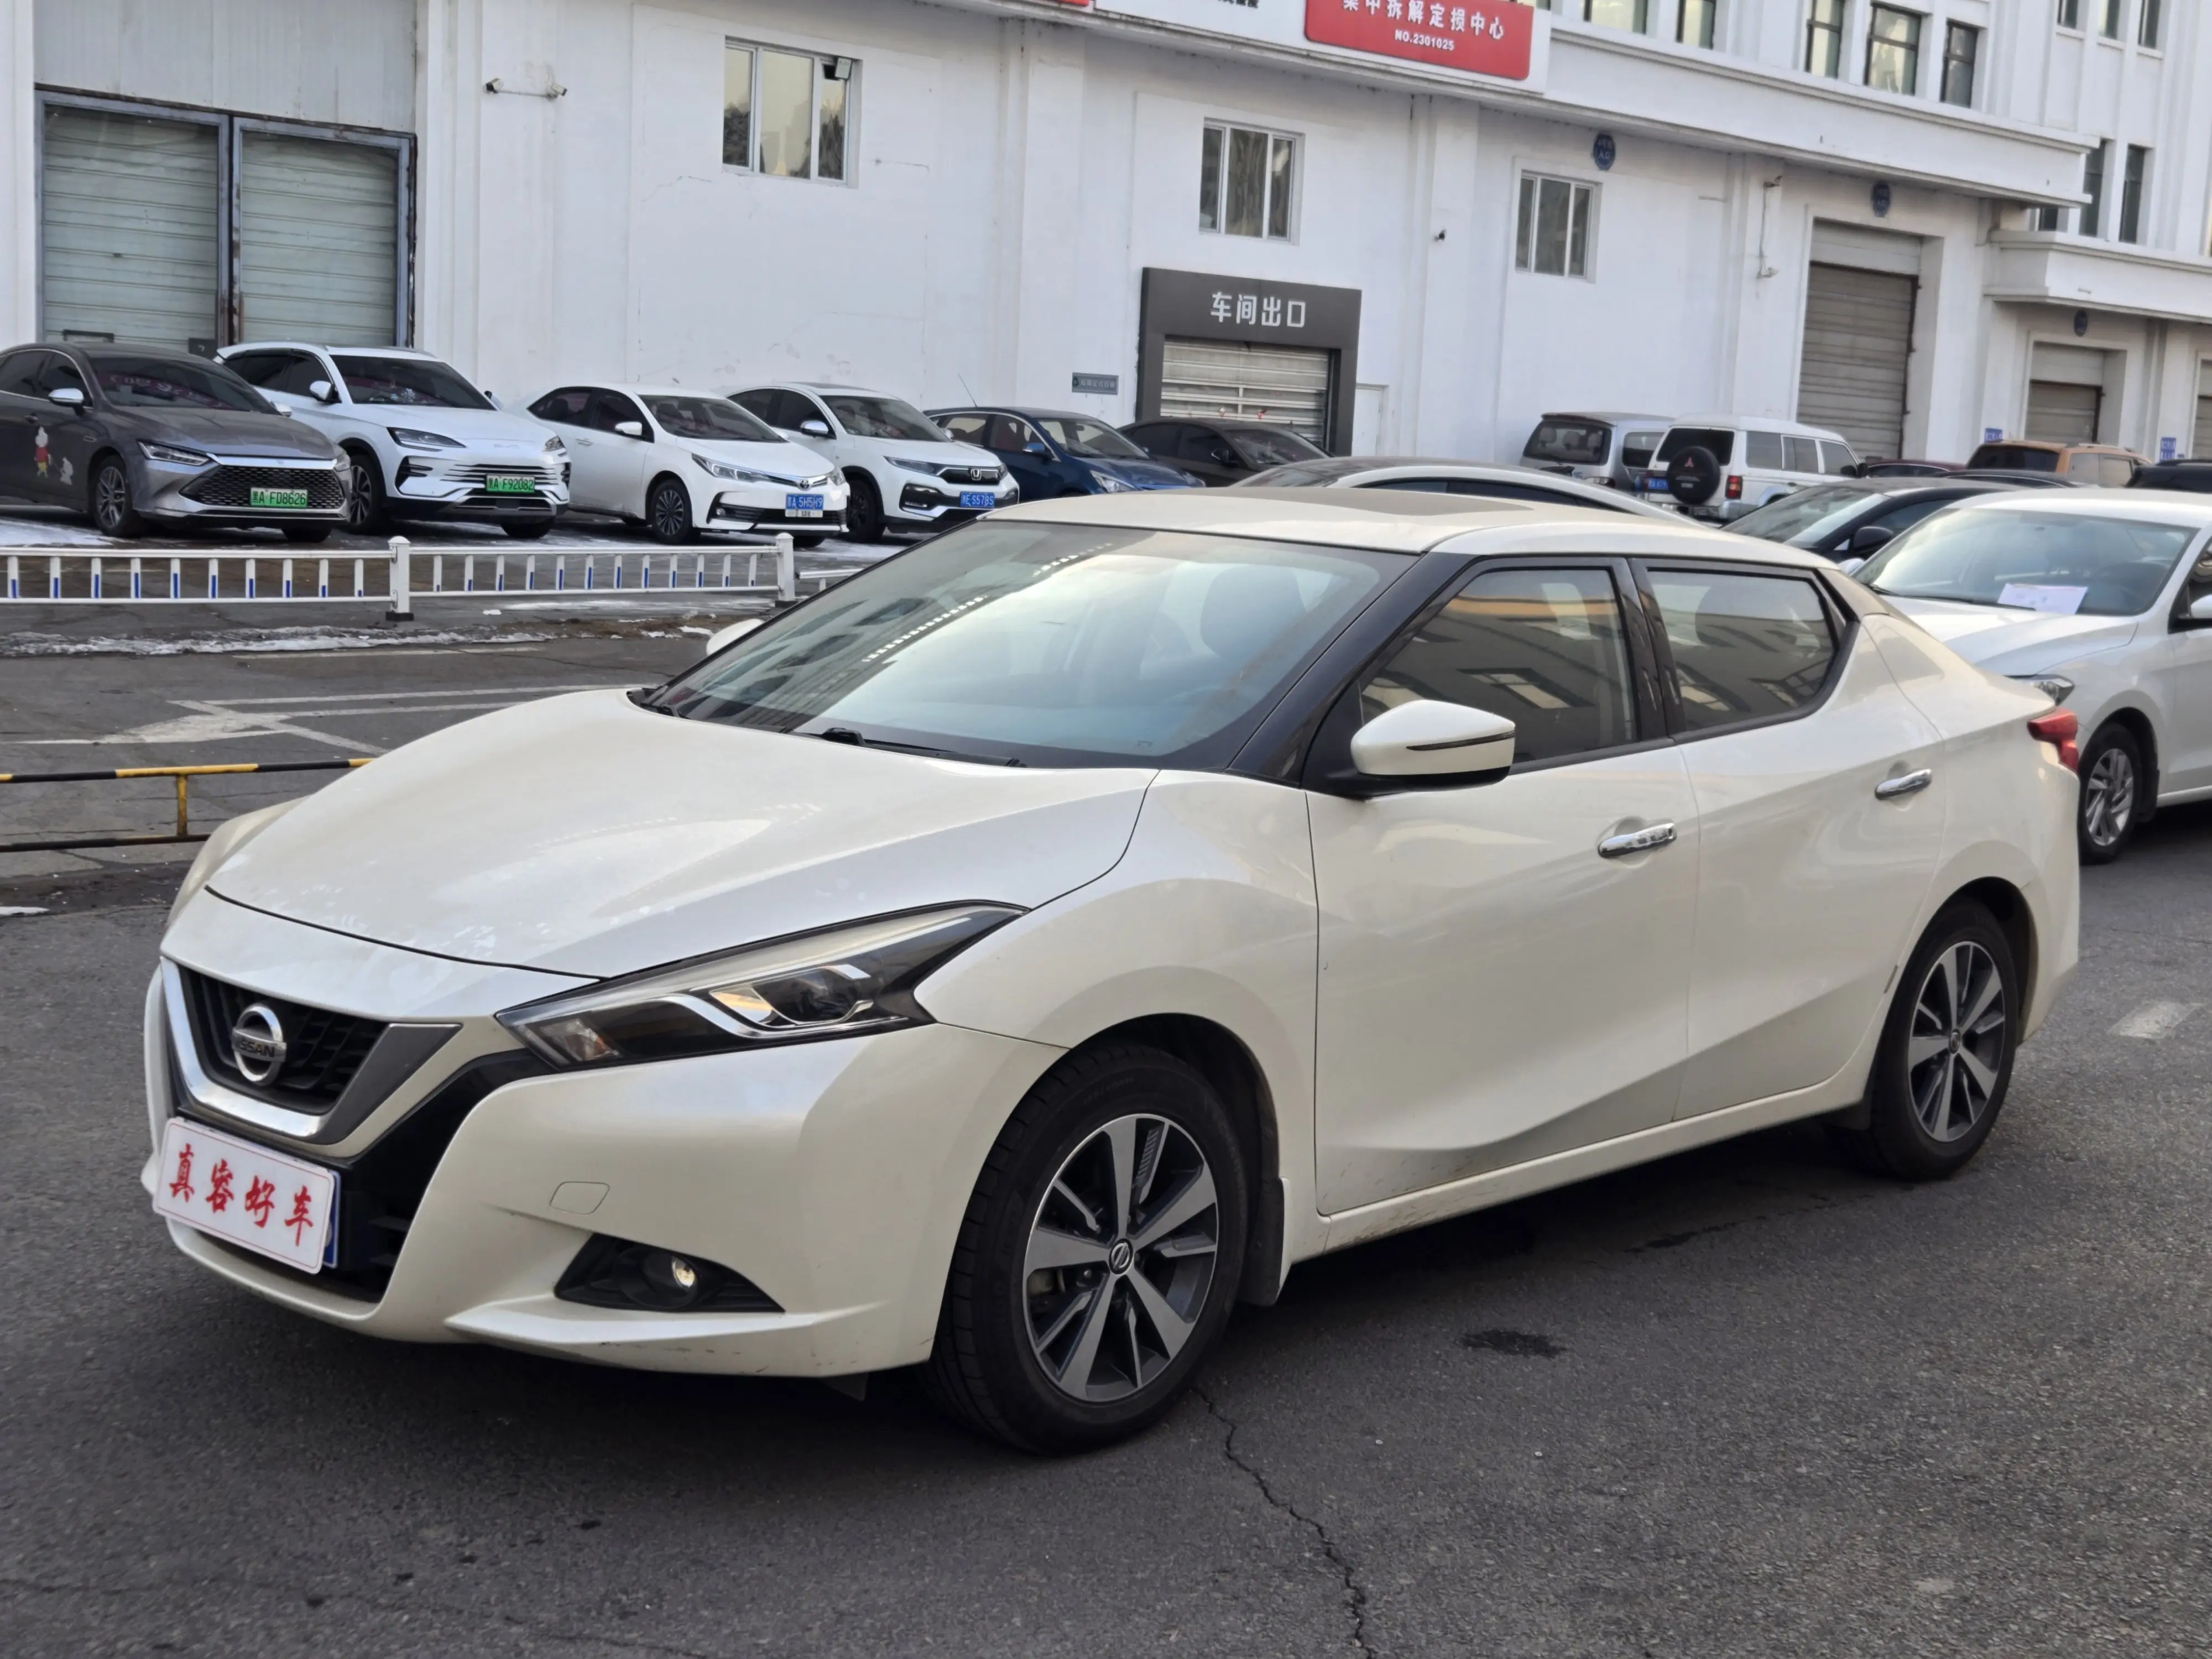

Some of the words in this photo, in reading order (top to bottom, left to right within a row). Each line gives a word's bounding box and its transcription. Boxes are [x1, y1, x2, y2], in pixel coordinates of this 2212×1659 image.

[1394, 29, 1454, 51] NO.2301025
[1211, 291, 1306, 328] 车间出口
